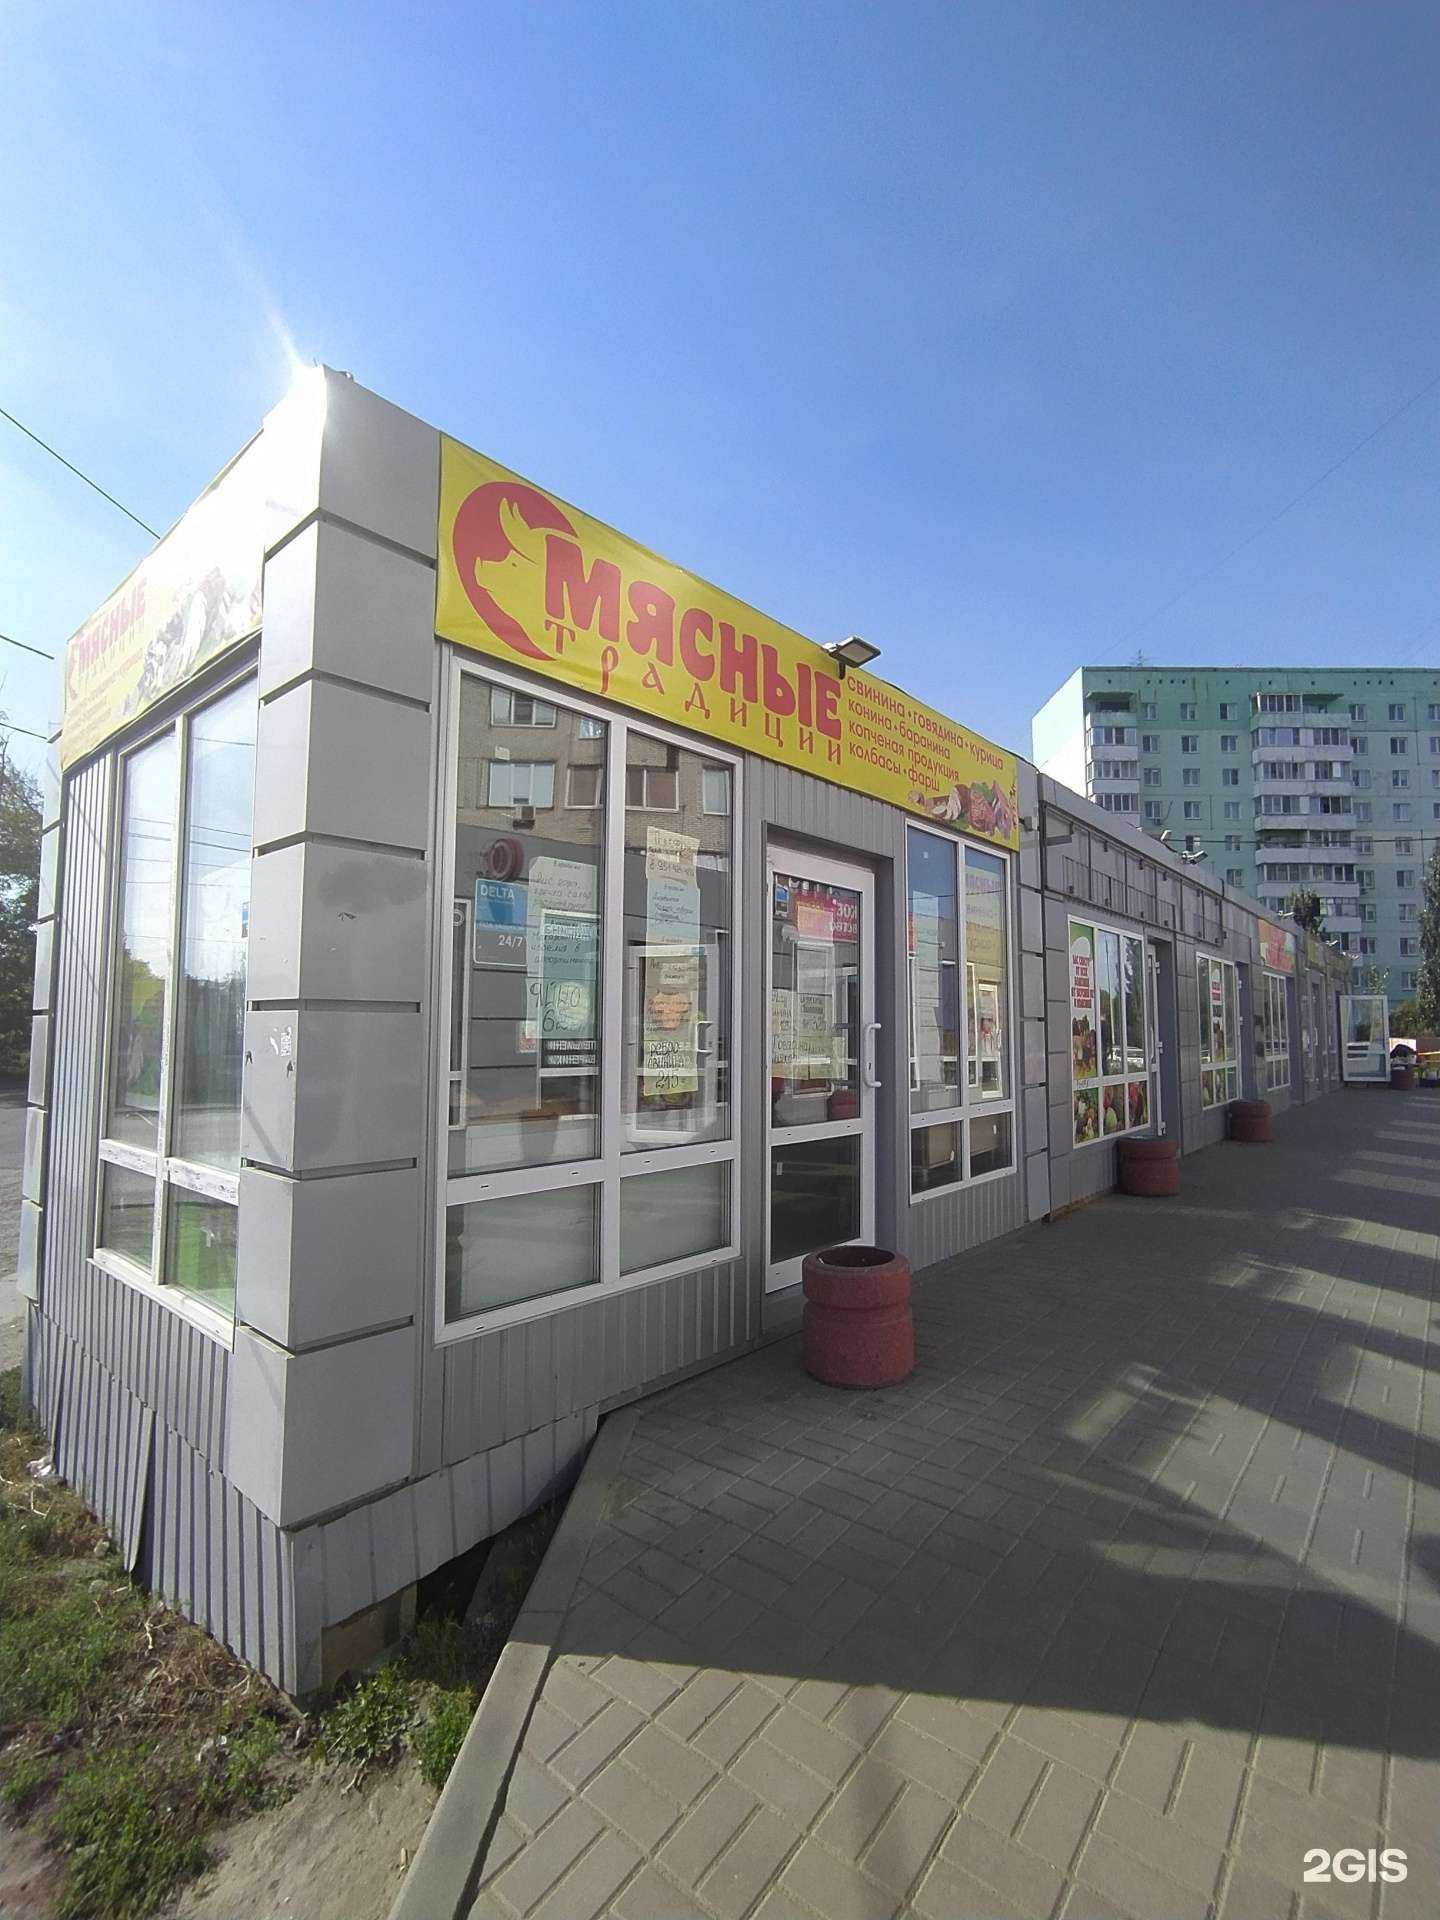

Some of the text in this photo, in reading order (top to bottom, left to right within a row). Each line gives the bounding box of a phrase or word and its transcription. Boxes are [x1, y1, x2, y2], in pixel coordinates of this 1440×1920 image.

[545, 534, 842, 740] МЯСНЫЕ
[544, 620, 841, 765] ТРАДИЦИИ
[847, 676, 1004, 771] свинина говядина курица
[848, 699, 951, 760] конина баранина
[849, 720, 960, 782] копченая продукция
[849, 742, 940, 793] колбасы фарш
[480, 884, 515, 899] DELTA
[498, 934, 524, 948] 24/7
